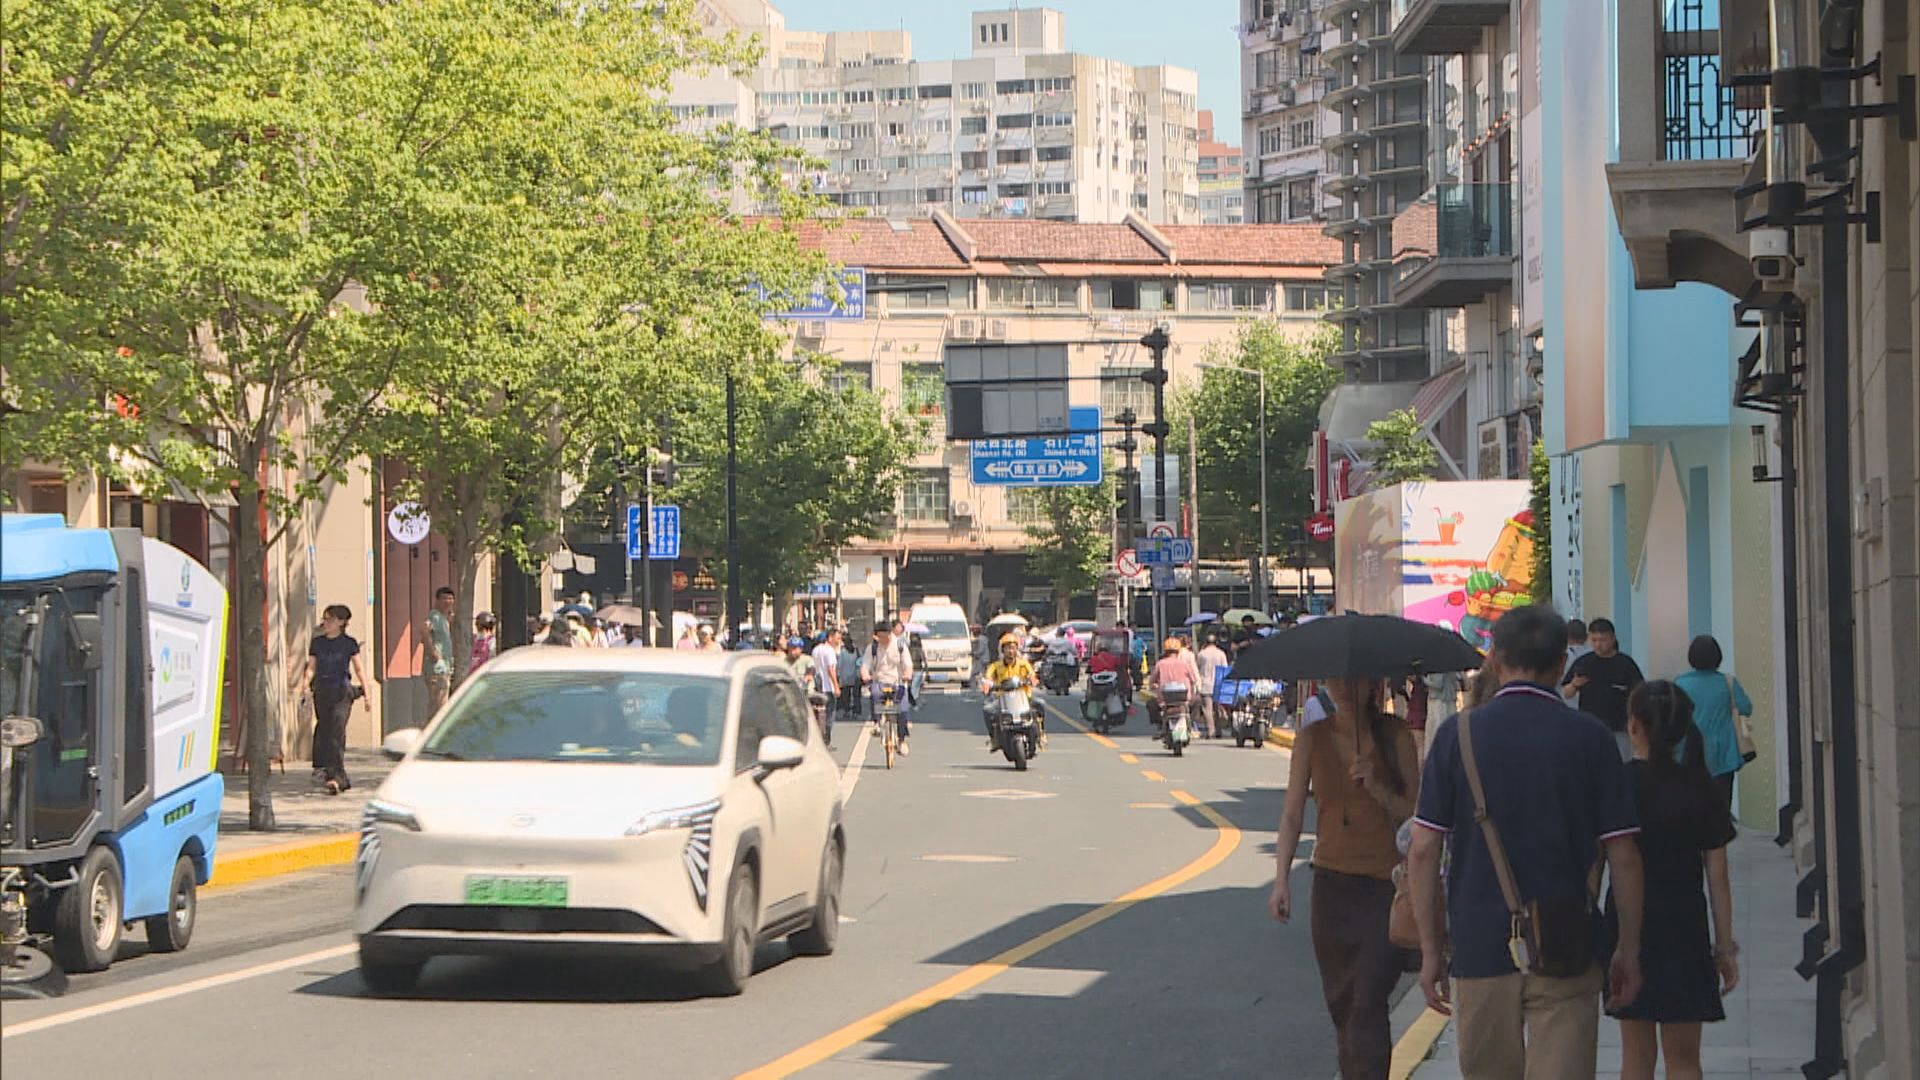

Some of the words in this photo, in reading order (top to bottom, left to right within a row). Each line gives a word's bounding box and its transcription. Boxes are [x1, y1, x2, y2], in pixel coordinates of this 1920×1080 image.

[1014, 463, 1058, 475] 南京西路
[1311, 523, 1333, 536] Tims
